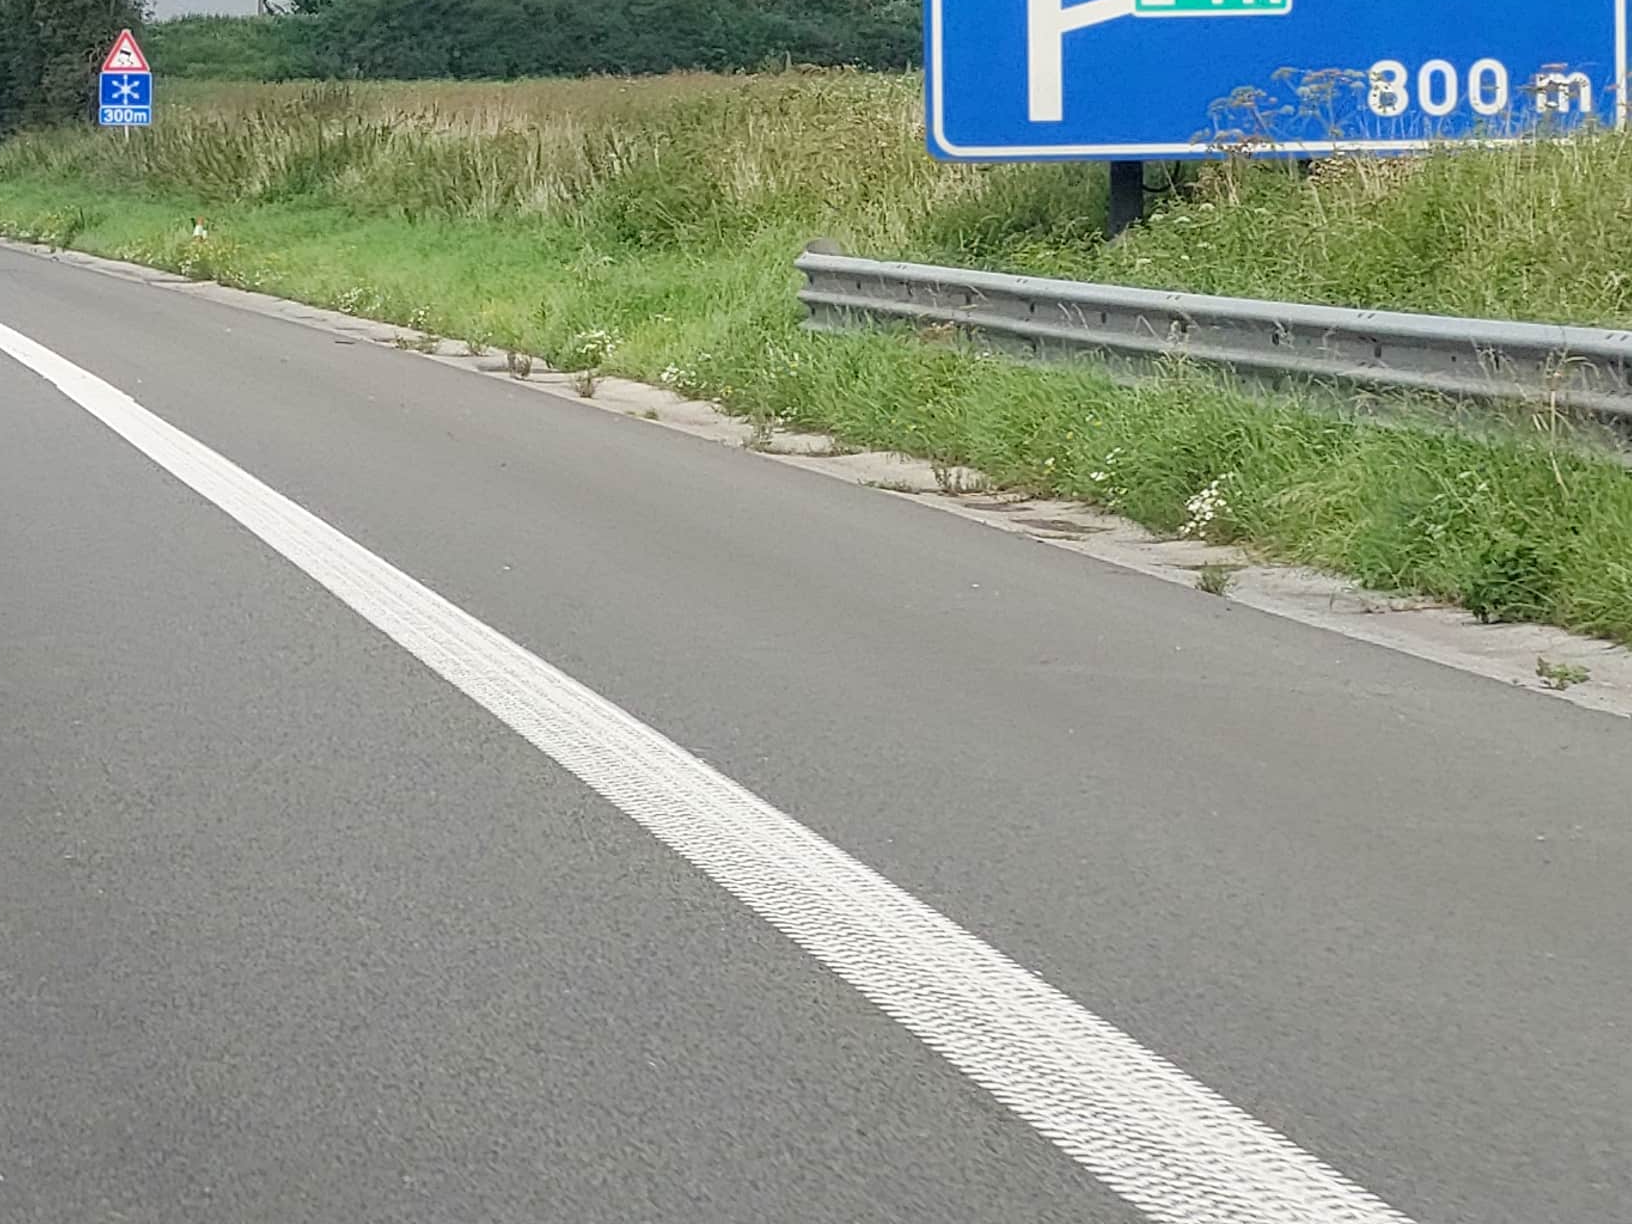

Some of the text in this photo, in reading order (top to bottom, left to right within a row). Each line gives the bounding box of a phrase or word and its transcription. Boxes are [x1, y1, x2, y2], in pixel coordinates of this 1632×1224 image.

[1367, 58, 1592, 118] 800 m
[104, 109, 147, 122] 300m
